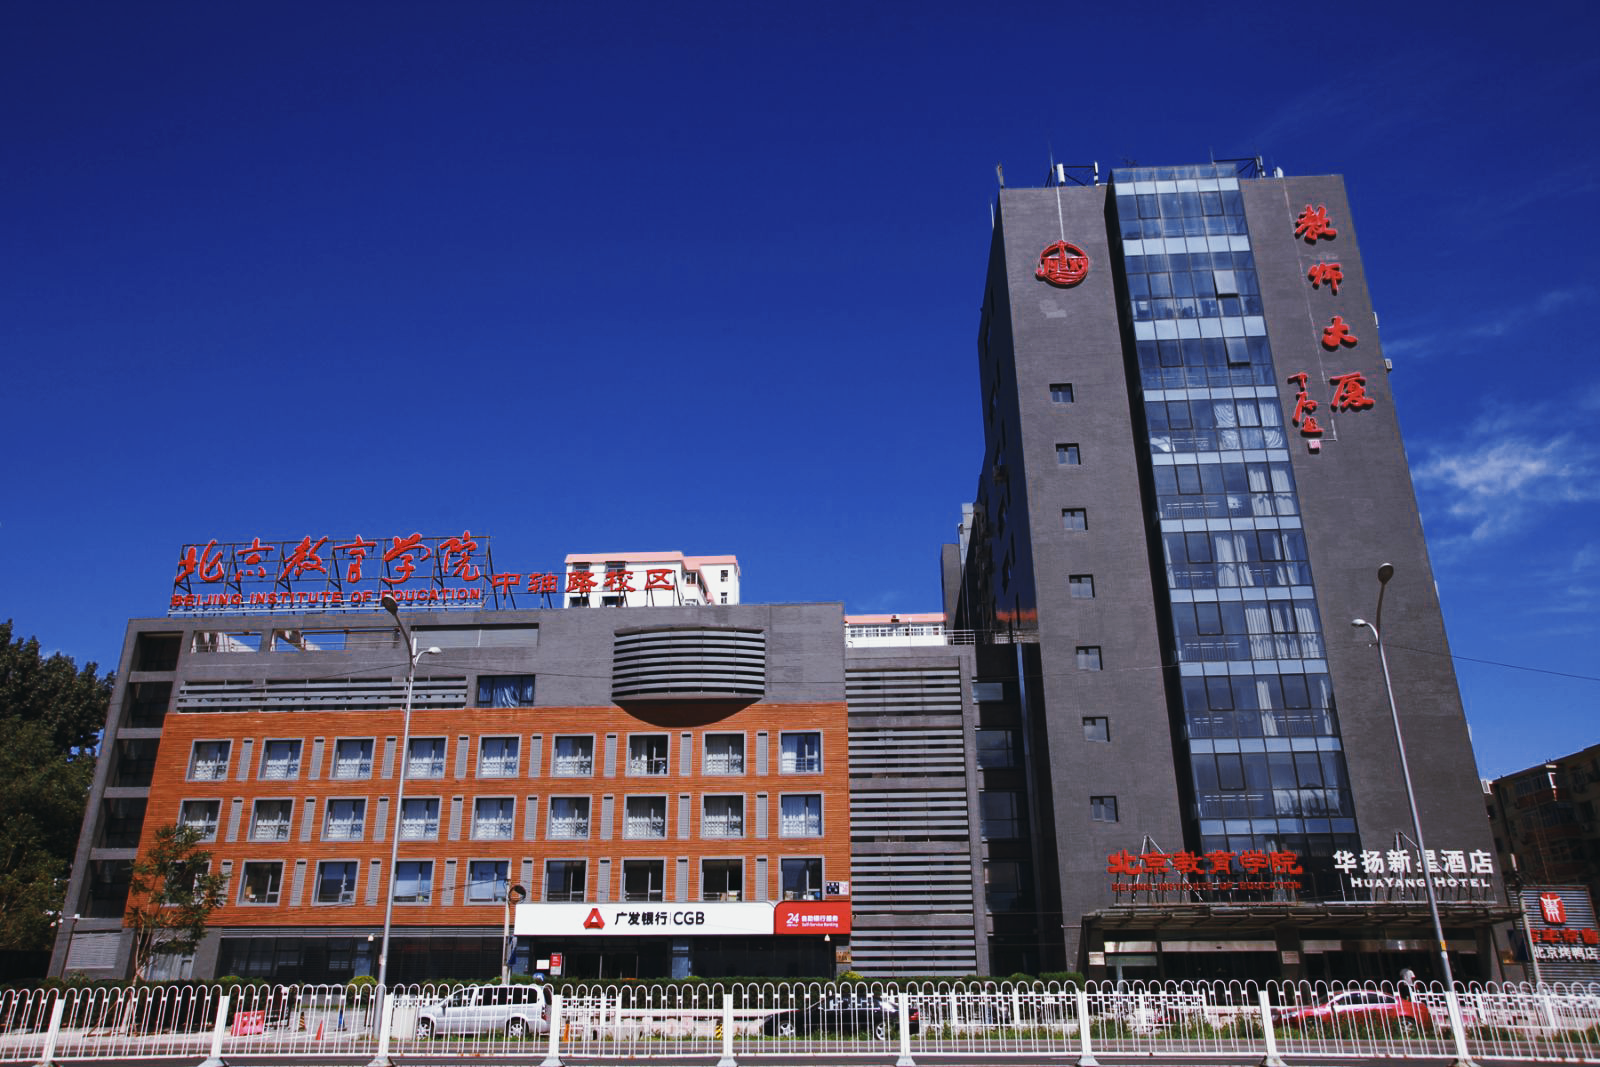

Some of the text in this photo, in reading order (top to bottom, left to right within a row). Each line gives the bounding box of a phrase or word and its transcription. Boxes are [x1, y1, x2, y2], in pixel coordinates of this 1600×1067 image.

[1294, 203, 1376, 413] 教师大厦
[175, 530, 481, 583] 北京教育学院
[491, 569, 675, 594] 中轴路校区
[171, 593, 243, 607] BEIJING
[250, 591, 344, 606] INSTITUTE
[351, 590, 374, 604] OF
[1107, 849, 1304, 875] 北京教育学院
[1333, 849, 1494, 874] 华扬新星酒店
[614, 911, 667, 926] 广发银行
[673, 911, 705, 925] CGB
[786, 912, 800, 924] 24
[1535, 945, 1598, 960] 北京烤鸭店
